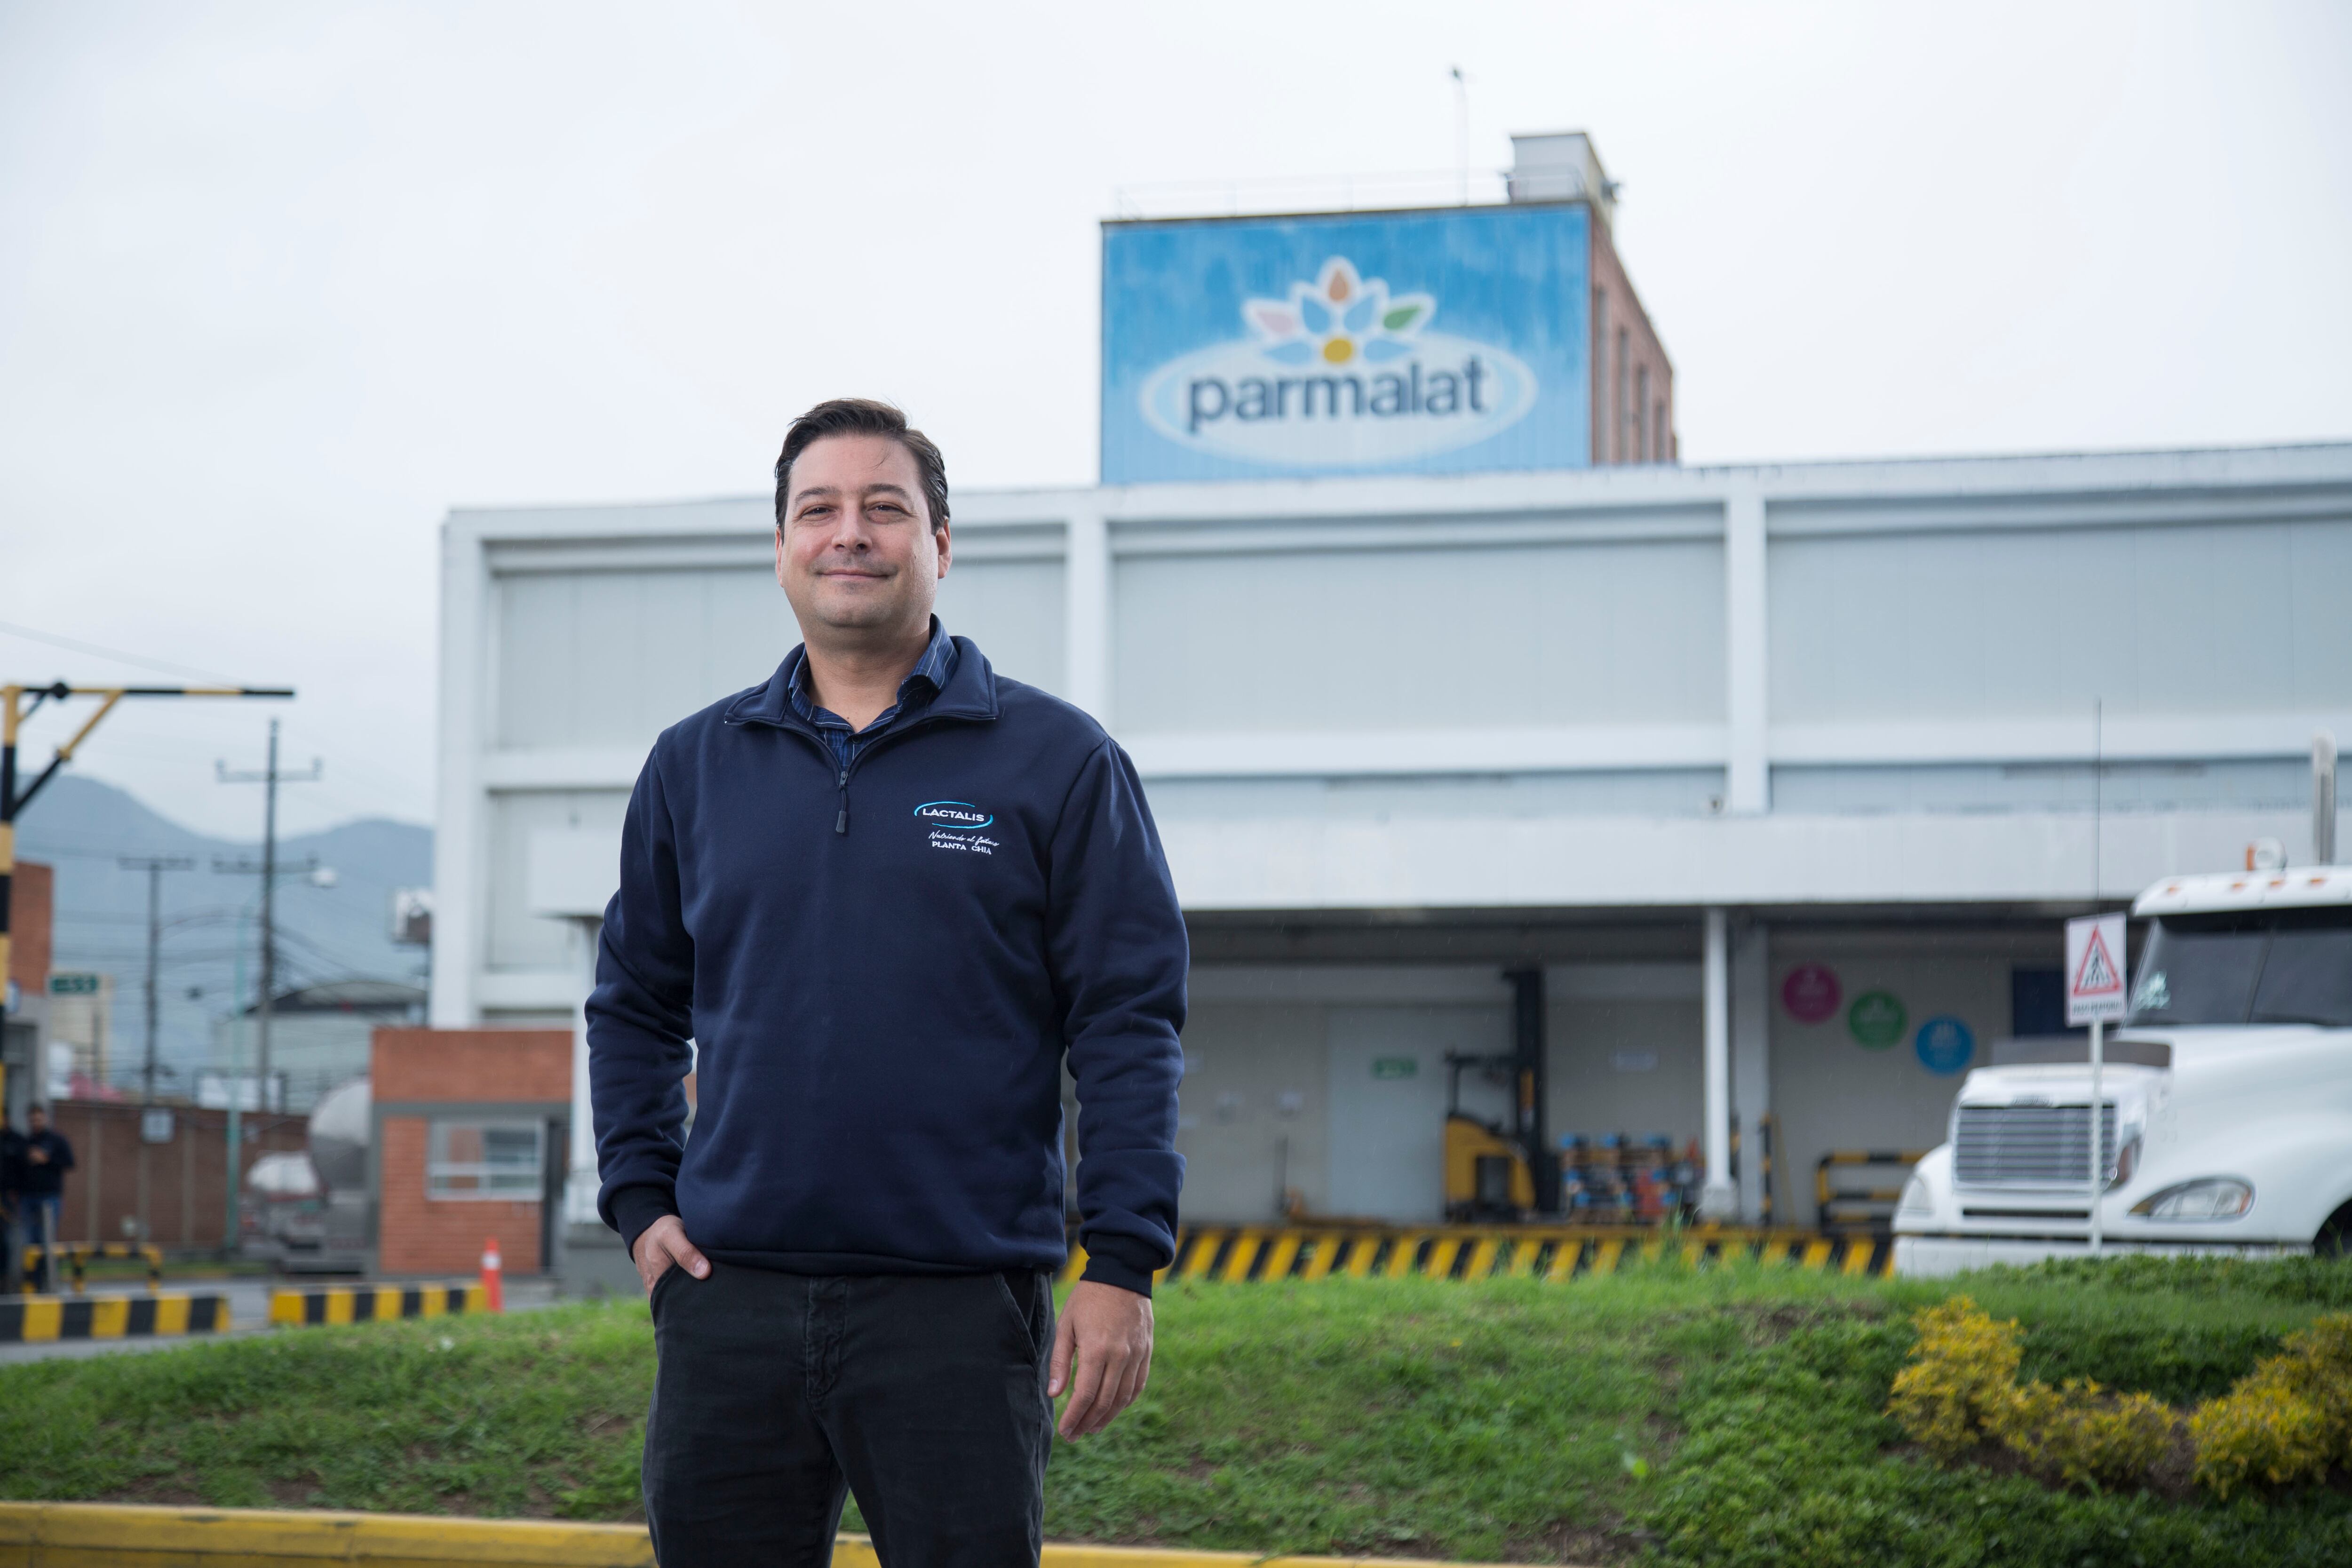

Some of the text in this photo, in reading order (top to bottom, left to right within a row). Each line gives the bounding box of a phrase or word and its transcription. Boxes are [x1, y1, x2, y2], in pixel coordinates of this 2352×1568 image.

[1186, 354, 1488, 435] parmalat
[922, 808, 985, 822] LACTALIS
[929, 830, 967, 841] Nutriendo
[932, 841, 992, 855] PLANTA CHIA
